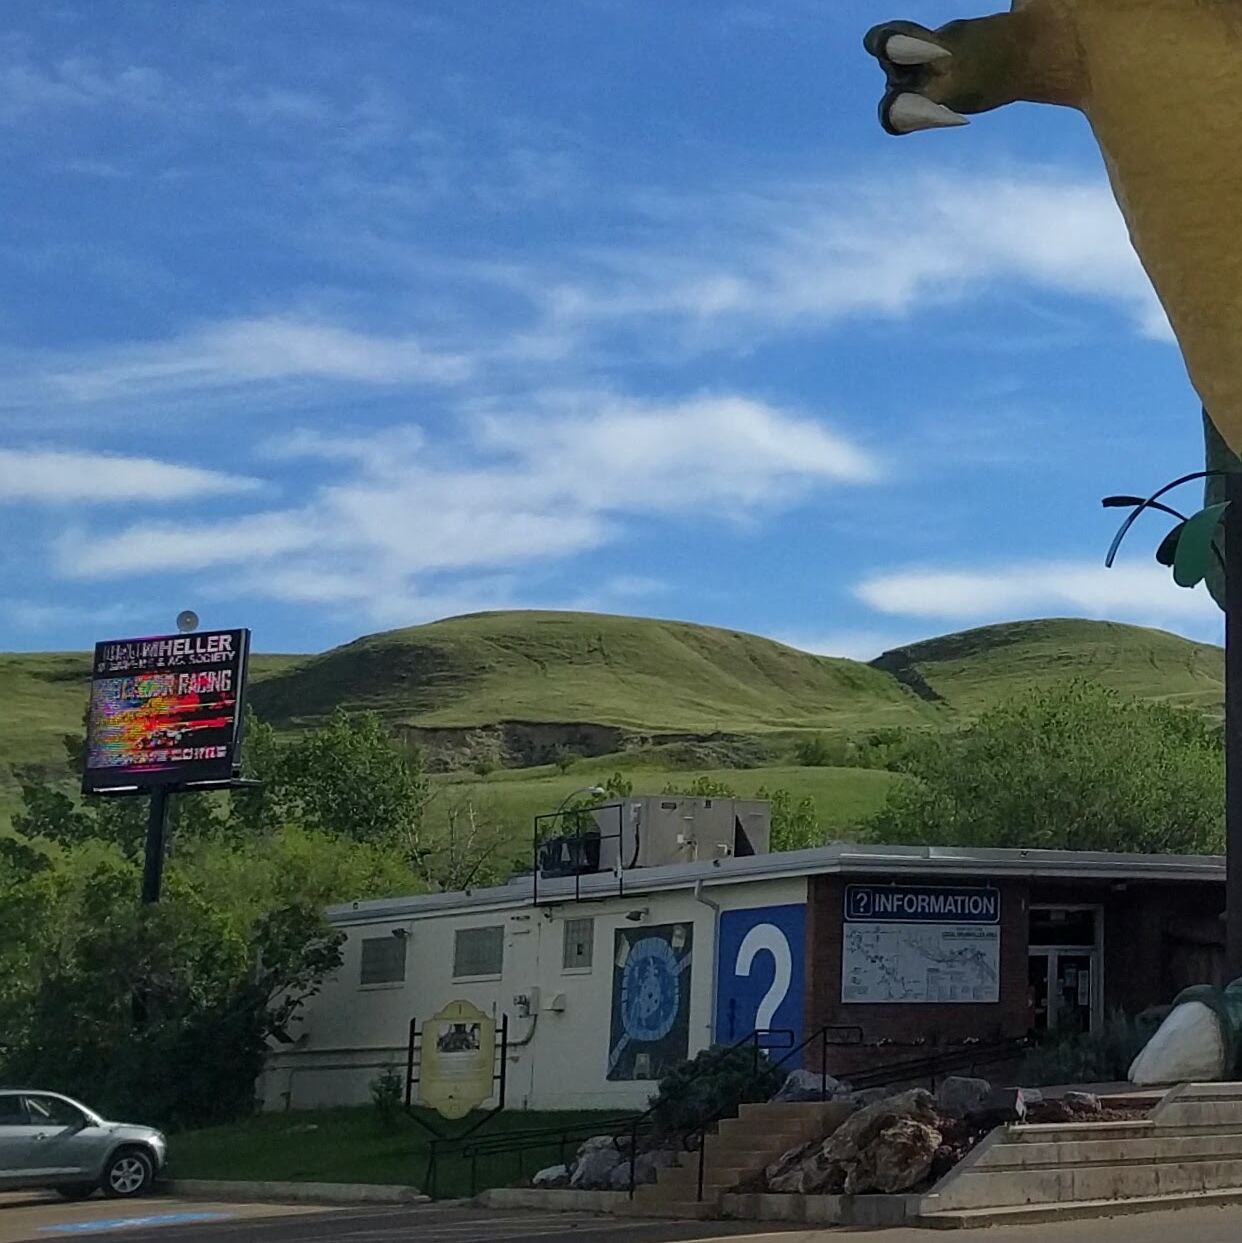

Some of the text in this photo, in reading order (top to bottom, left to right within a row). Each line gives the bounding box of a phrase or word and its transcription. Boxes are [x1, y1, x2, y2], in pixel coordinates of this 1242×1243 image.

[189, 651, 236, 665] SOCIETY
[178, 669, 232, 695] RACING
[874, 893, 995, 915] INFORMATION
